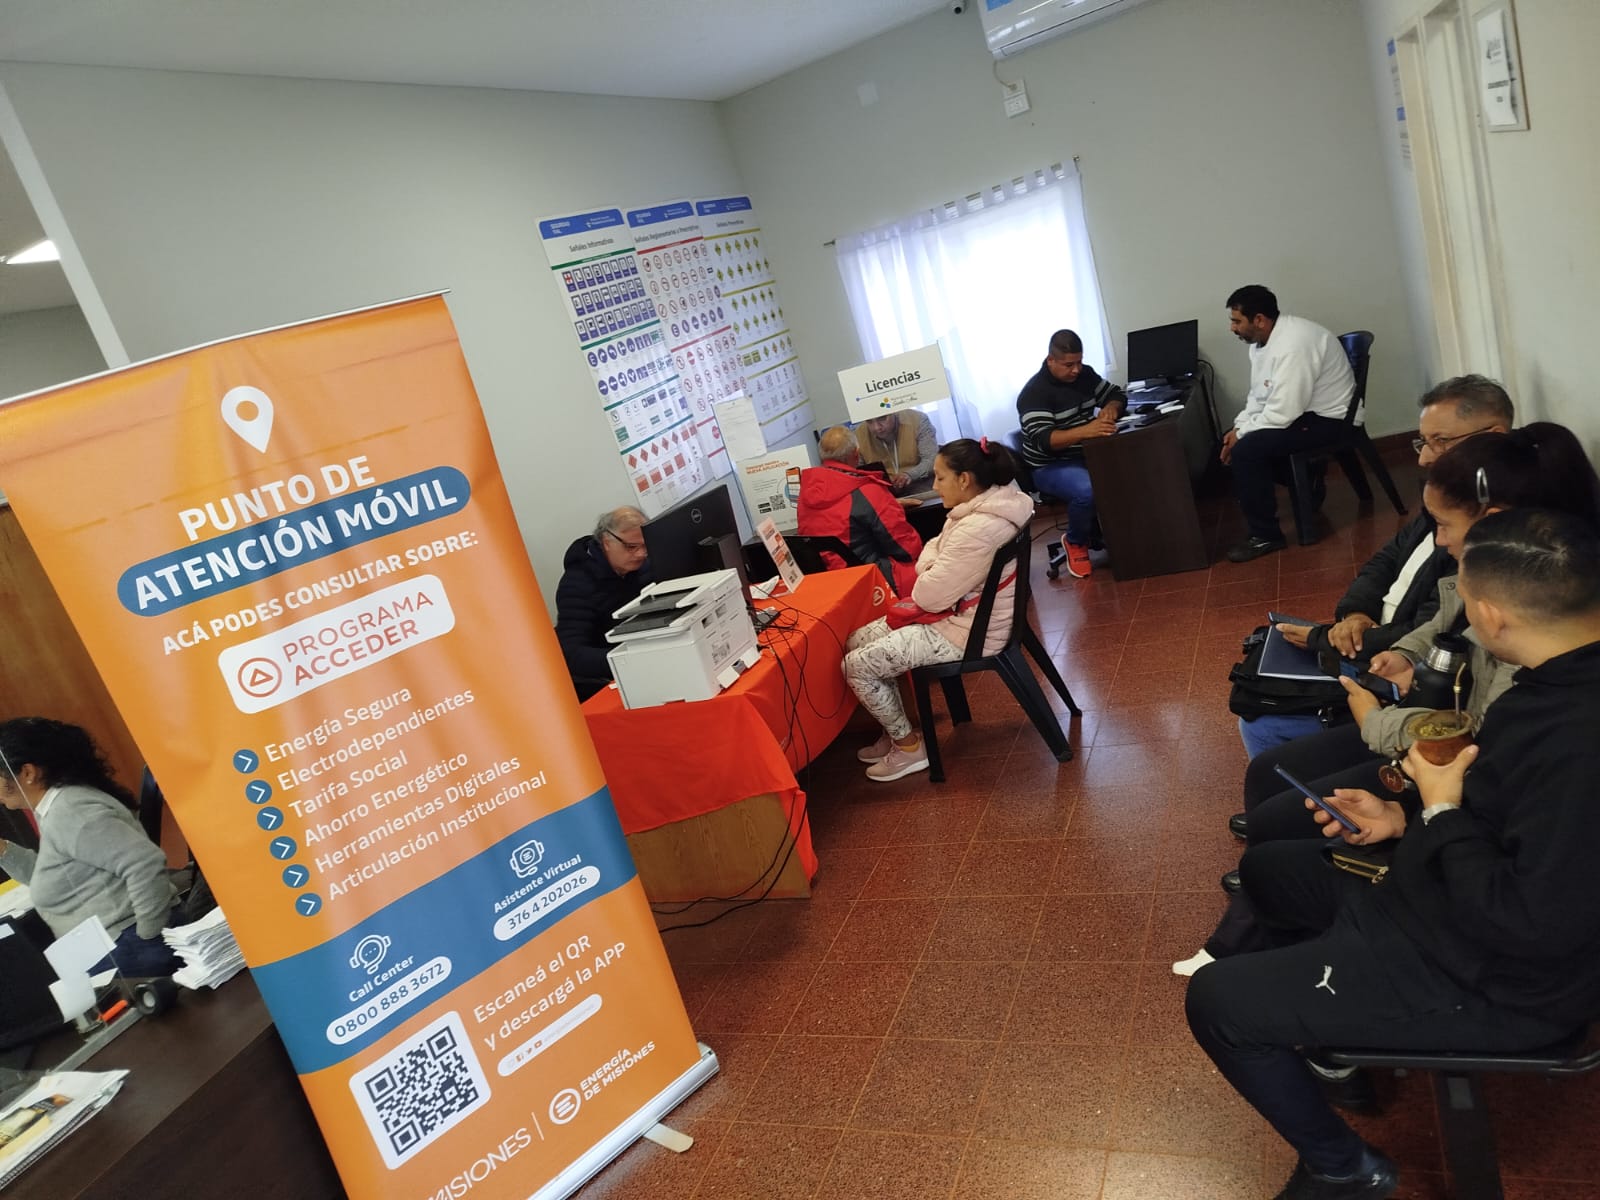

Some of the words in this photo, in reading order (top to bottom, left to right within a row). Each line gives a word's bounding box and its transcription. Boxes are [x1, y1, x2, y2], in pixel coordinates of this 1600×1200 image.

[865, 371, 921, 393] Licencias
[177, 474, 316, 541] PUNTO
[320, 455, 376, 495] DE
[134, 515, 334, 610] ATENCIÓN
[335, 479, 458, 537] MÓVIL
[162, 621, 210, 655] ACÁ
[210, 598, 284, 638] PODES
[284, 555, 405, 610] CONSULTAR
[405, 530, 480, 567] SOBRE:
[282, 591, 434, 662] PROGRAMA
[293, 619, 420, 686] ACCEDER
[264, 718, 344, 763] Energía
[344, 687, 413, 728] Segura
[277, 689, 475, 791] Electrodependientes
[288, 779, 349, 819] Tarifa
[350, 750, 409, 790] Social
[304, 803, 369, 847] Ahorro
[371, 752, 469, 811] Energético
[315, 798, 445, 874] Herramientas
[445, 755, 521, 803] Digitales
[328, 829, 440, 901] Articulación
[442, 771, 548, 837] Institucional
[493, 875, 545, 914] Asistente
[544, 854, 582, 882] Virtual
[507, 909, 531, 931] 376
[532, 901, 541, 915] 4
[541, 873, 588, 907] 202026
[333, 1006, 379, 1039] 0800
[380, 985, 408, 1012] 888
[409, 962, 445, 996] 3672
[348, 980, 374, 1002] Call
[374, 954, 414, 987] Center
[473, 963, 547, 1024] Escaneá
[548, 957, 565, 977] el
[565, 935, 592, 965] QR
[484, 1029, 499, 1051] y
[499, 977, 576, 1041] descargá
[577, 966, 593, 987] la
[593, 942, 627, 974] APP
[580, 1047, 631, 1091] ENERGÍA
[583, 1085, 601, 1101] DE
[601, 1041, 656, 1087] MISIONES
